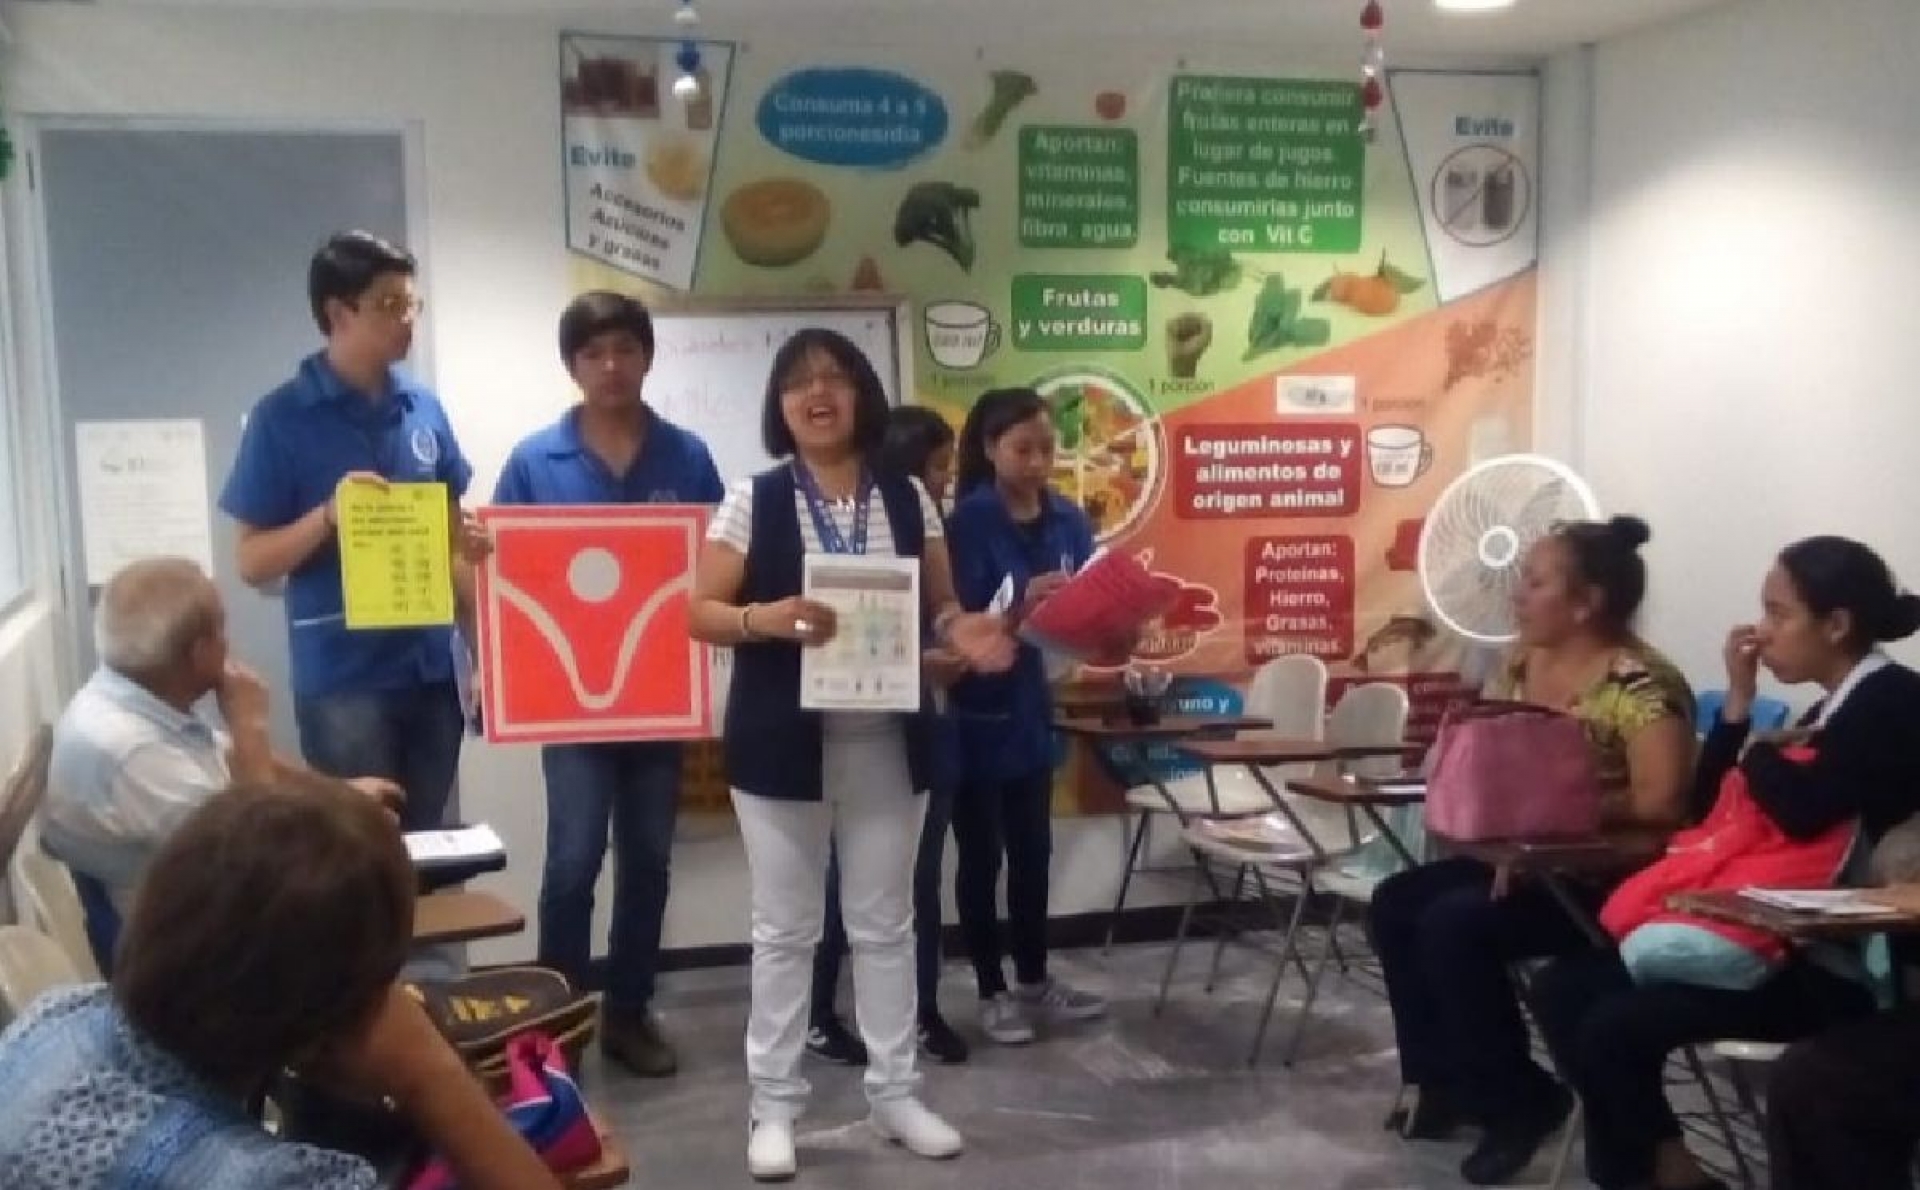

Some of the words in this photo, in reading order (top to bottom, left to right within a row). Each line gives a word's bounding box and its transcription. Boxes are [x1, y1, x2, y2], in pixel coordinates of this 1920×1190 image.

[774, 94, 874, 115] Consuma
[1260, 87, 1354, 107] consumir
[1182, 111, 1240, 133] frutas
[1325, 119, 1349, 135] en
[1455, 115, 1513, 136] Evite
[570, 145, 636, 168] Evite
[1193, 139, 1243, 166] lugar
[1248, 141, 1273, 161] de
[1177, 166, 1257, 188] Fuentes
[1265, 170, 1289, 189] de
[1295, 169, 1352, 190] hierro
[1303, 199, 1355, 220] junto
[1218, 229, 1255, 244] con
[1042, 287, 1120, 308] Frutas
[1018, 319, 1031, 338] y
[1038, 317, 1142, 336] verduras
[1184, 435, 1332, 459] Leguminosas
[1340, 438, 1353, 458] y
[1196, 462, 1307, 483] alimentos
[1313, 461, 1341, 480] de
[1193, 490, 1262, 513] origen
[1269, 488, 1344, 508] animal
[1261, 541, 1337, 562] Aportan:
[1269, 589, 1331, 608] Hierro,
[1178, 697, 1213, 711] uno
[1219, 697, 1229, 714] y
